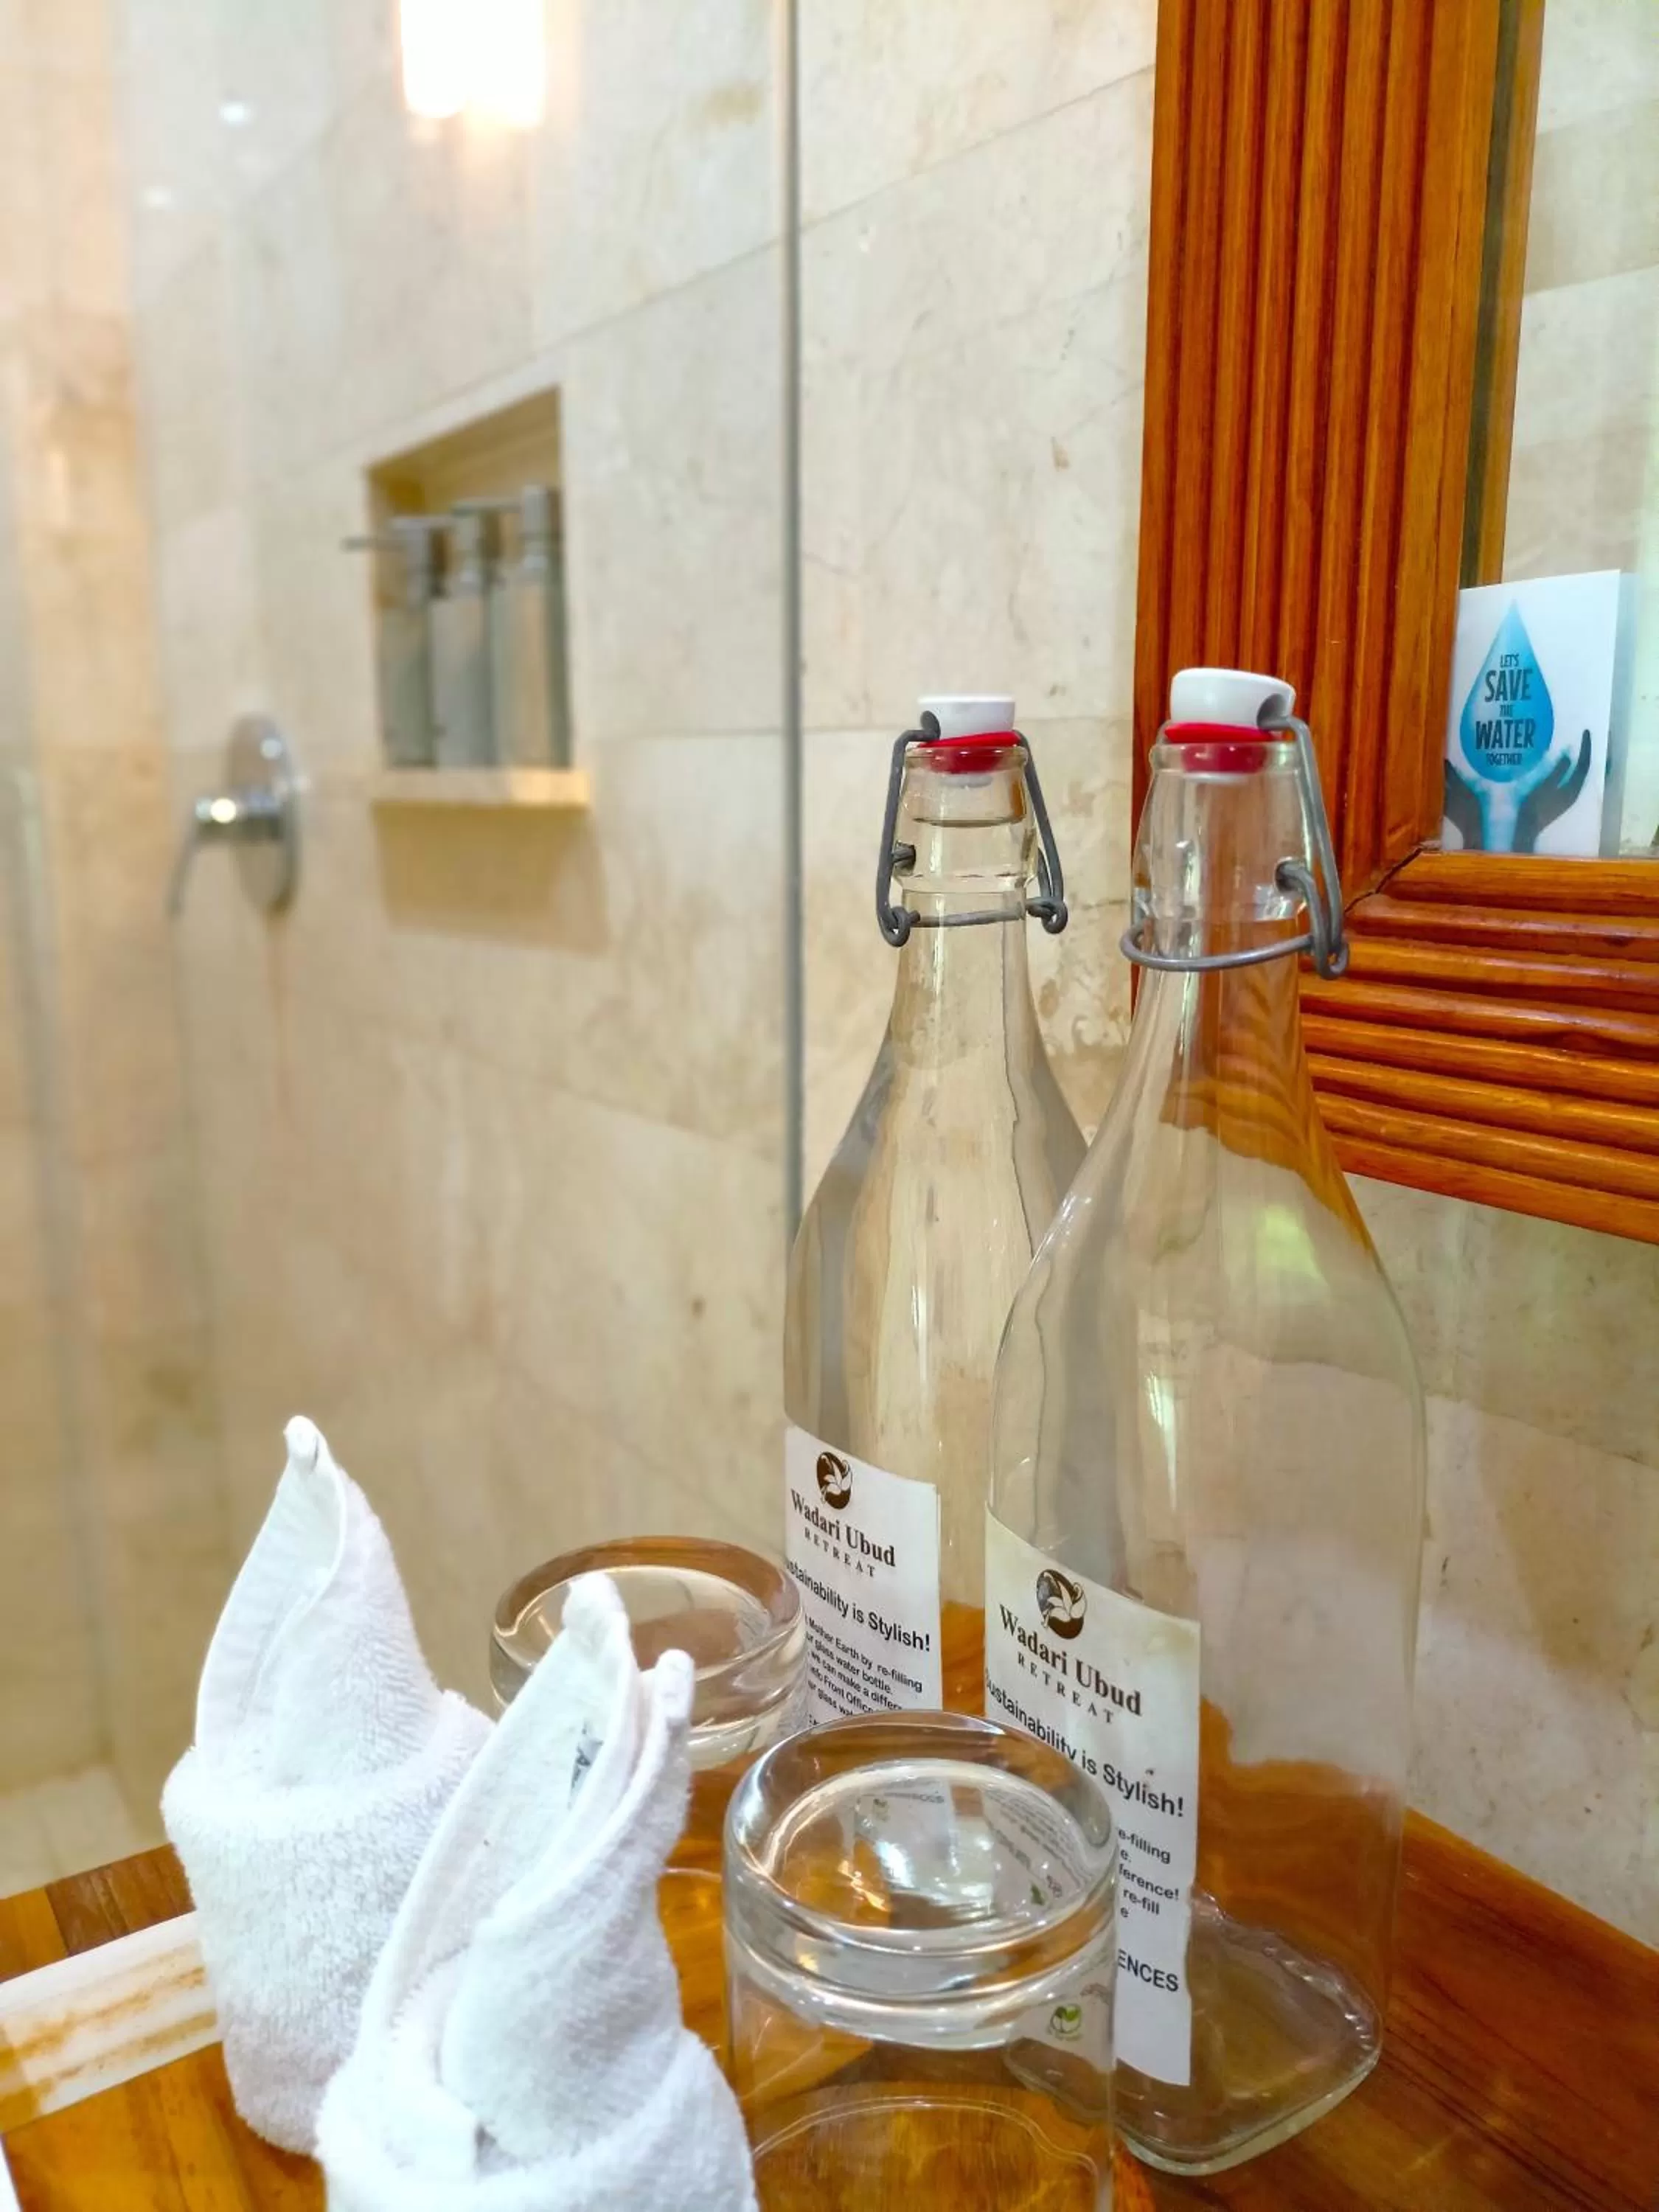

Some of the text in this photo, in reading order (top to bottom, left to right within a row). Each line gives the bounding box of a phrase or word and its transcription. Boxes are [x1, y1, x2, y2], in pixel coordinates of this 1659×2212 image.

[1484, 669, 1533, 702] SAVE
[1499, 705, 1513, 717] THE
[1475, 718, 1536, 749] WATER
[1486, 753, 1523, 766] TOGETHER
[790, 1488, 896, 1567] Wadari Ubud
[804, 1527, 875, 1577] RETREAT
[852, 1602, 865, 1623] is
[868, 1612, 930, 1652] Stylish!
[809, 1617, 834, 1643] Mother
[835, 1638, 859, 1660] Earth
[861, 1653, 873, 1669] by
[877, 1665, 922, 1693] re-filling
[999, 1603, 1142, 1716] Wadari Ubud
[822, 1659, 836, 1675] can
[838, 1669, 862, 1692] make
[863, 1688, 869, 1696] a
[824, 1674, 845, 1700] Front
[836, 1656, 860, 1676] water
[863, 1669, 893, 1694] bottle.
[1017, 1651, 1114, 1726] RETREAT
[1082, 1750, 1097, 1775] is
[1103, 1763, 1183, 1818] Stylish!
[1118, 1827, 1171, 1865] e-filling
[1123, 1888, 1160, 1915] re-fill
[1118, 1948, 1180, 1992] ENCES
